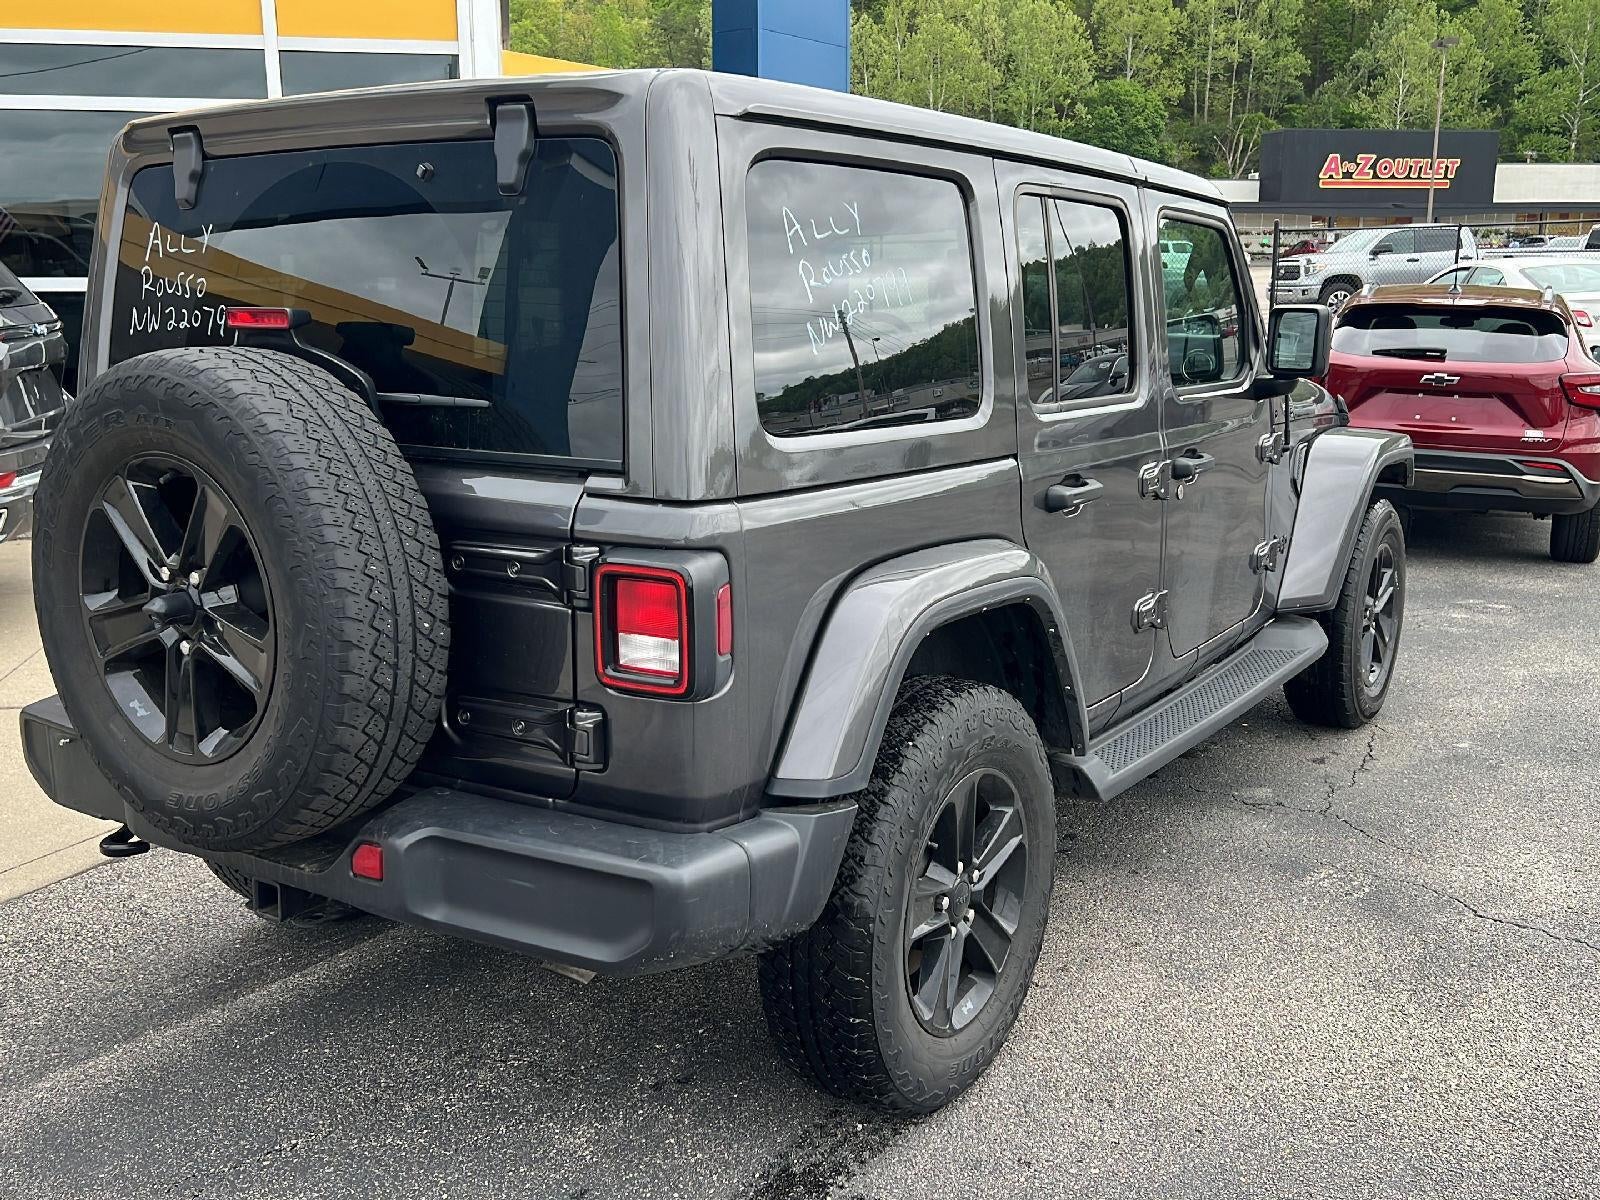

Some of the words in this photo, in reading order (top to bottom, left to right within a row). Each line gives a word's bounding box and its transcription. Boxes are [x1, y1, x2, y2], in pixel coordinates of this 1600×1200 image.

[1376, 157, 1460, 178] OUTLET
[145, 221, 213, 262] ALLY
[783, 200, 864, 254] ALLY
[129, 302, 232, 342] NW22079
